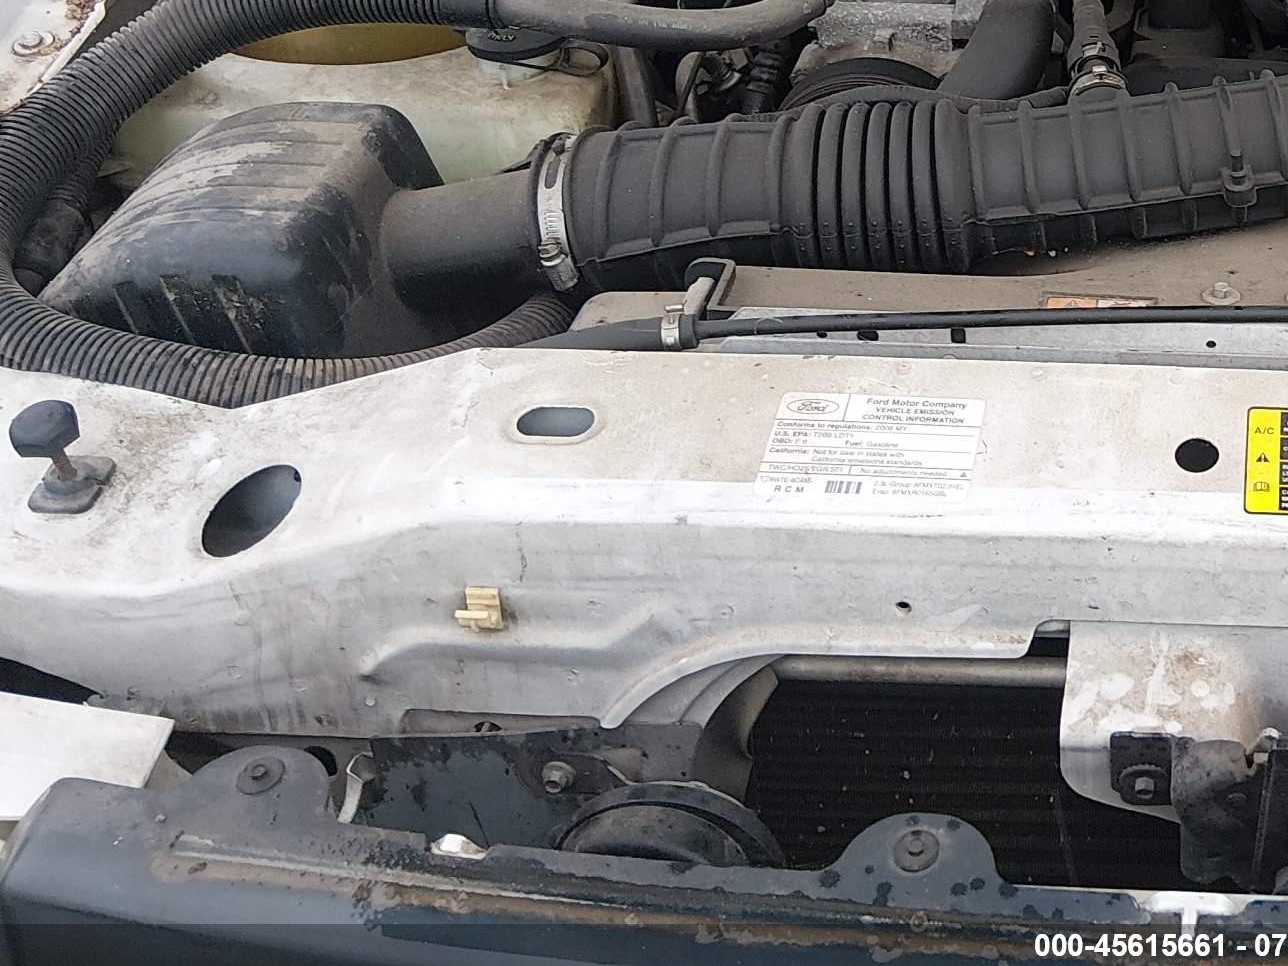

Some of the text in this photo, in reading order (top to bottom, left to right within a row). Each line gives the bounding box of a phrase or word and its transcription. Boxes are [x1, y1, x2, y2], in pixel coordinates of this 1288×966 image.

[796, 400, 829, 411] Ford
[920, 400, 967, 410] Company
[1254, 426, 1274, 434] A/C
